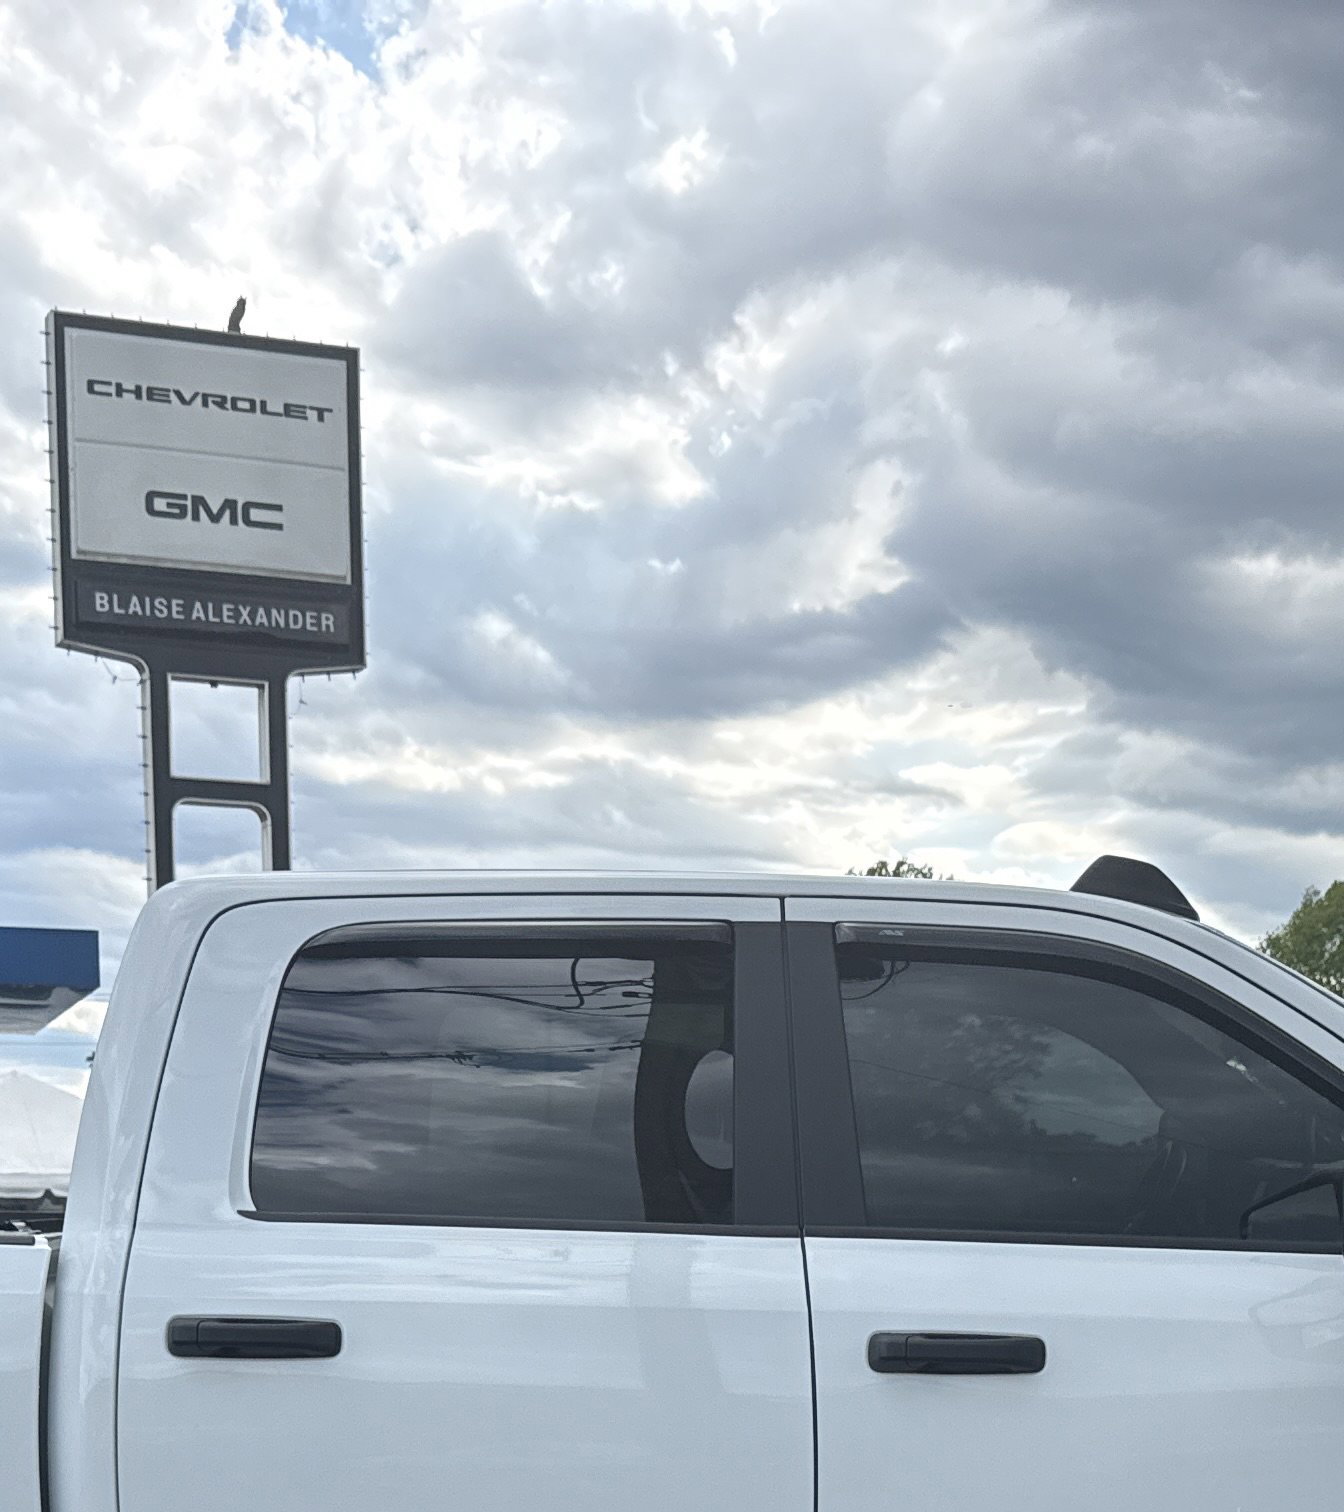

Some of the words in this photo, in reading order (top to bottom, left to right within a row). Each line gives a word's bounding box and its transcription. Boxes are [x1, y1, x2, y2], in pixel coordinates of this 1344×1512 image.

[86, 378, 333, 424] CHEVROLET
[144, 489, 284, 532] GMC
[94, 591, 185, 620] BLAISE
[191, 601, 336, 633] ALEXANDER
